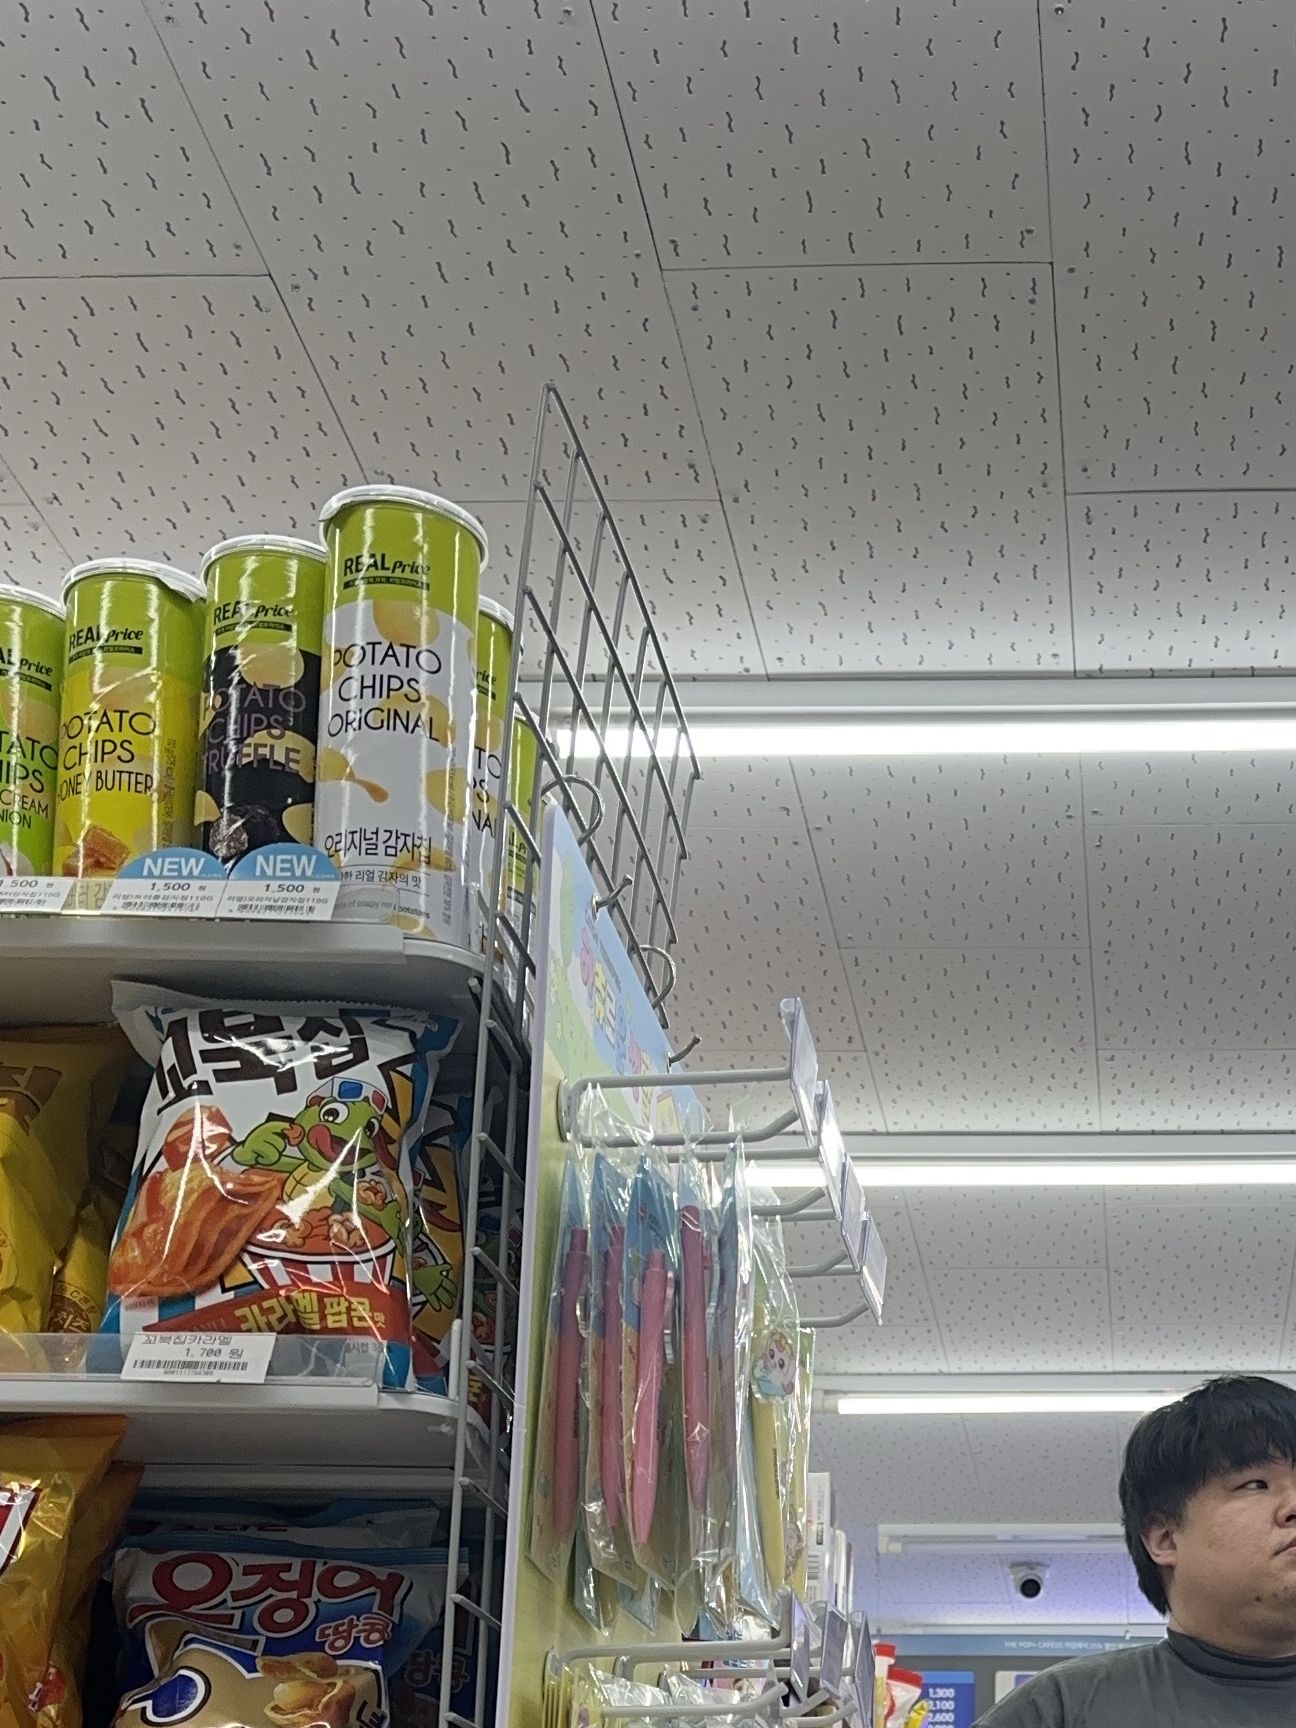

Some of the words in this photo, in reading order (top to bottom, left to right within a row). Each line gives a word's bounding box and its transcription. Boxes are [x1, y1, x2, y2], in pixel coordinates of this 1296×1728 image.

[344, 553, 389, 576] REAL
[214, 601, 249, 625] REA
[338, 674, 421, 703] CHIPS
[208, 713, 286, 744] CHIPS
[328, 707, 439, 742] ORIGINAL
[63, 739, 135, 770] CHIPS
[201, 742, 301, 773] TRUFFLE
[58, 776, 92, 802] ONEY
[95, 770, 153, 795] BUTTER
[143, 857, 205, 877] NEW
[256, 855, 317, 877] NEW
[150, 882, 191, 892] 1,500
[264, 884, 305, 893] 1,500
[184, 1348, 222, 1359] 1,700
[228, 1348, 243, 1360] 원
[129, 1552, 405, 1638] 오징어
[316, 1614, 393, 1654] 땅콩
